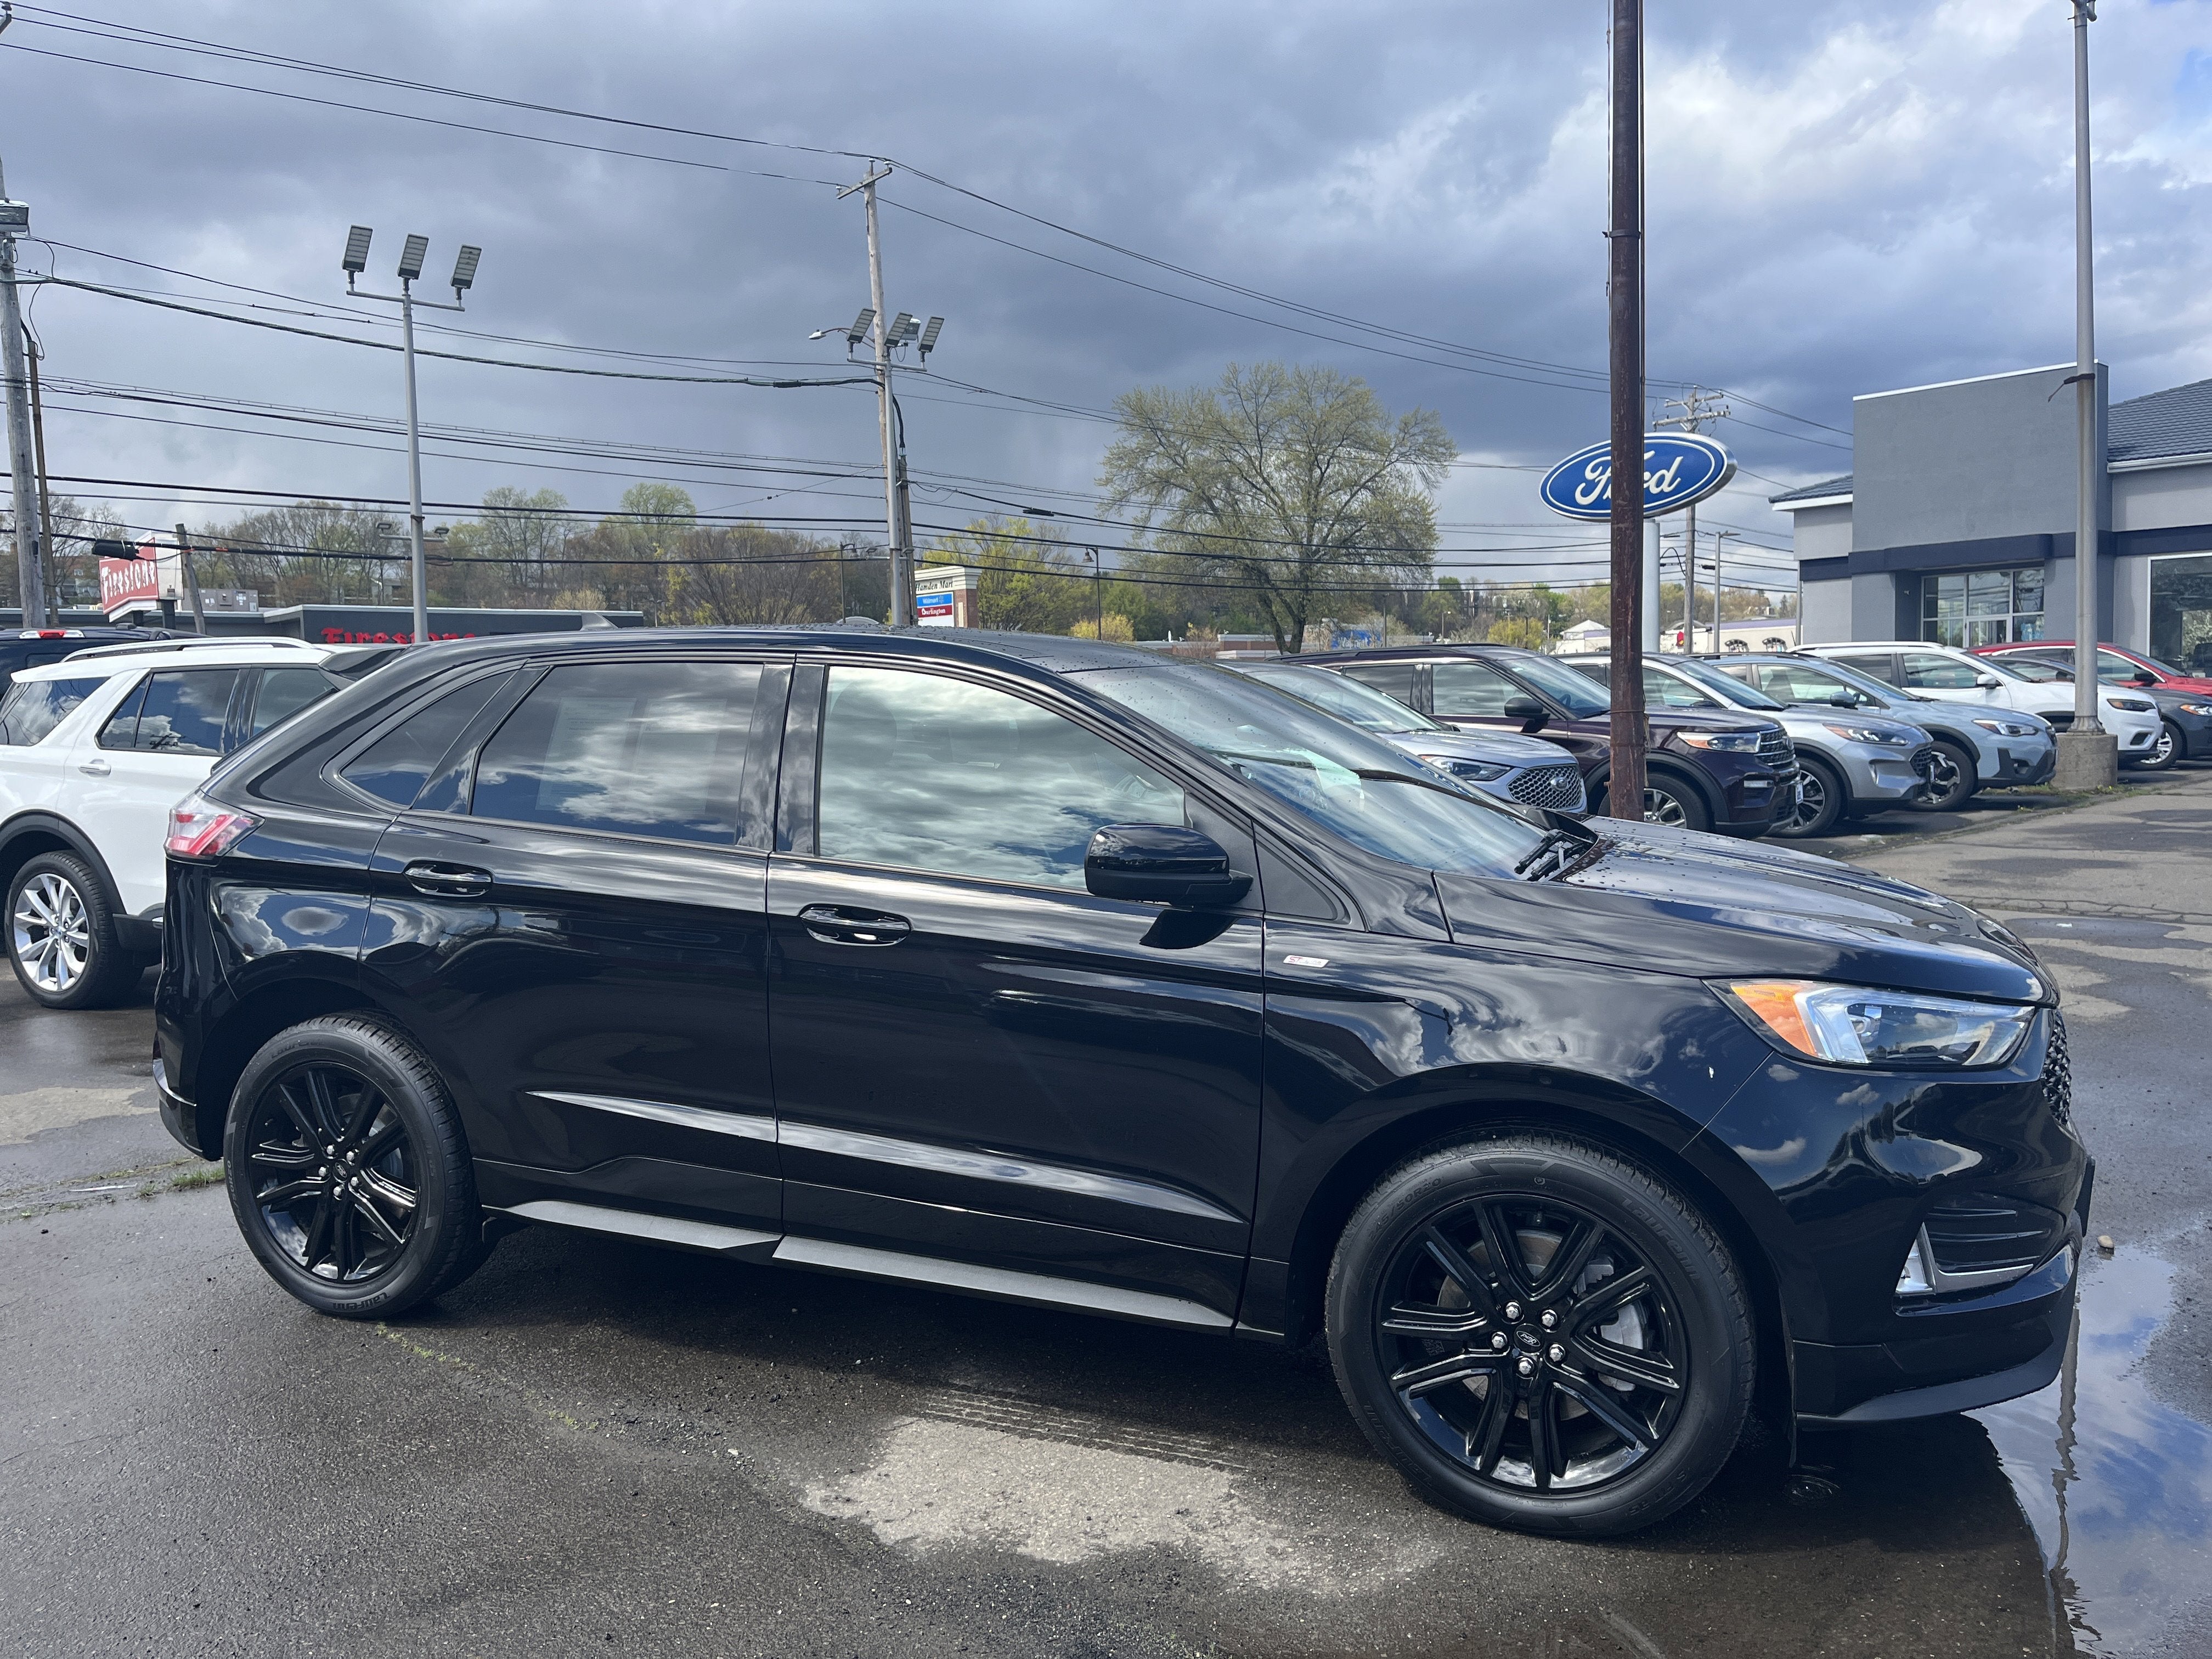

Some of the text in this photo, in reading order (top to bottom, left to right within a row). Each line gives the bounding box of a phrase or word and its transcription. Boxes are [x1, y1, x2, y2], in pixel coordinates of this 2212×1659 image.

[1575, 450, 1684, 505] Fd
[101, 560, 155, 605] Firestone
[916, 580, 953, 591] Hamden Mart
